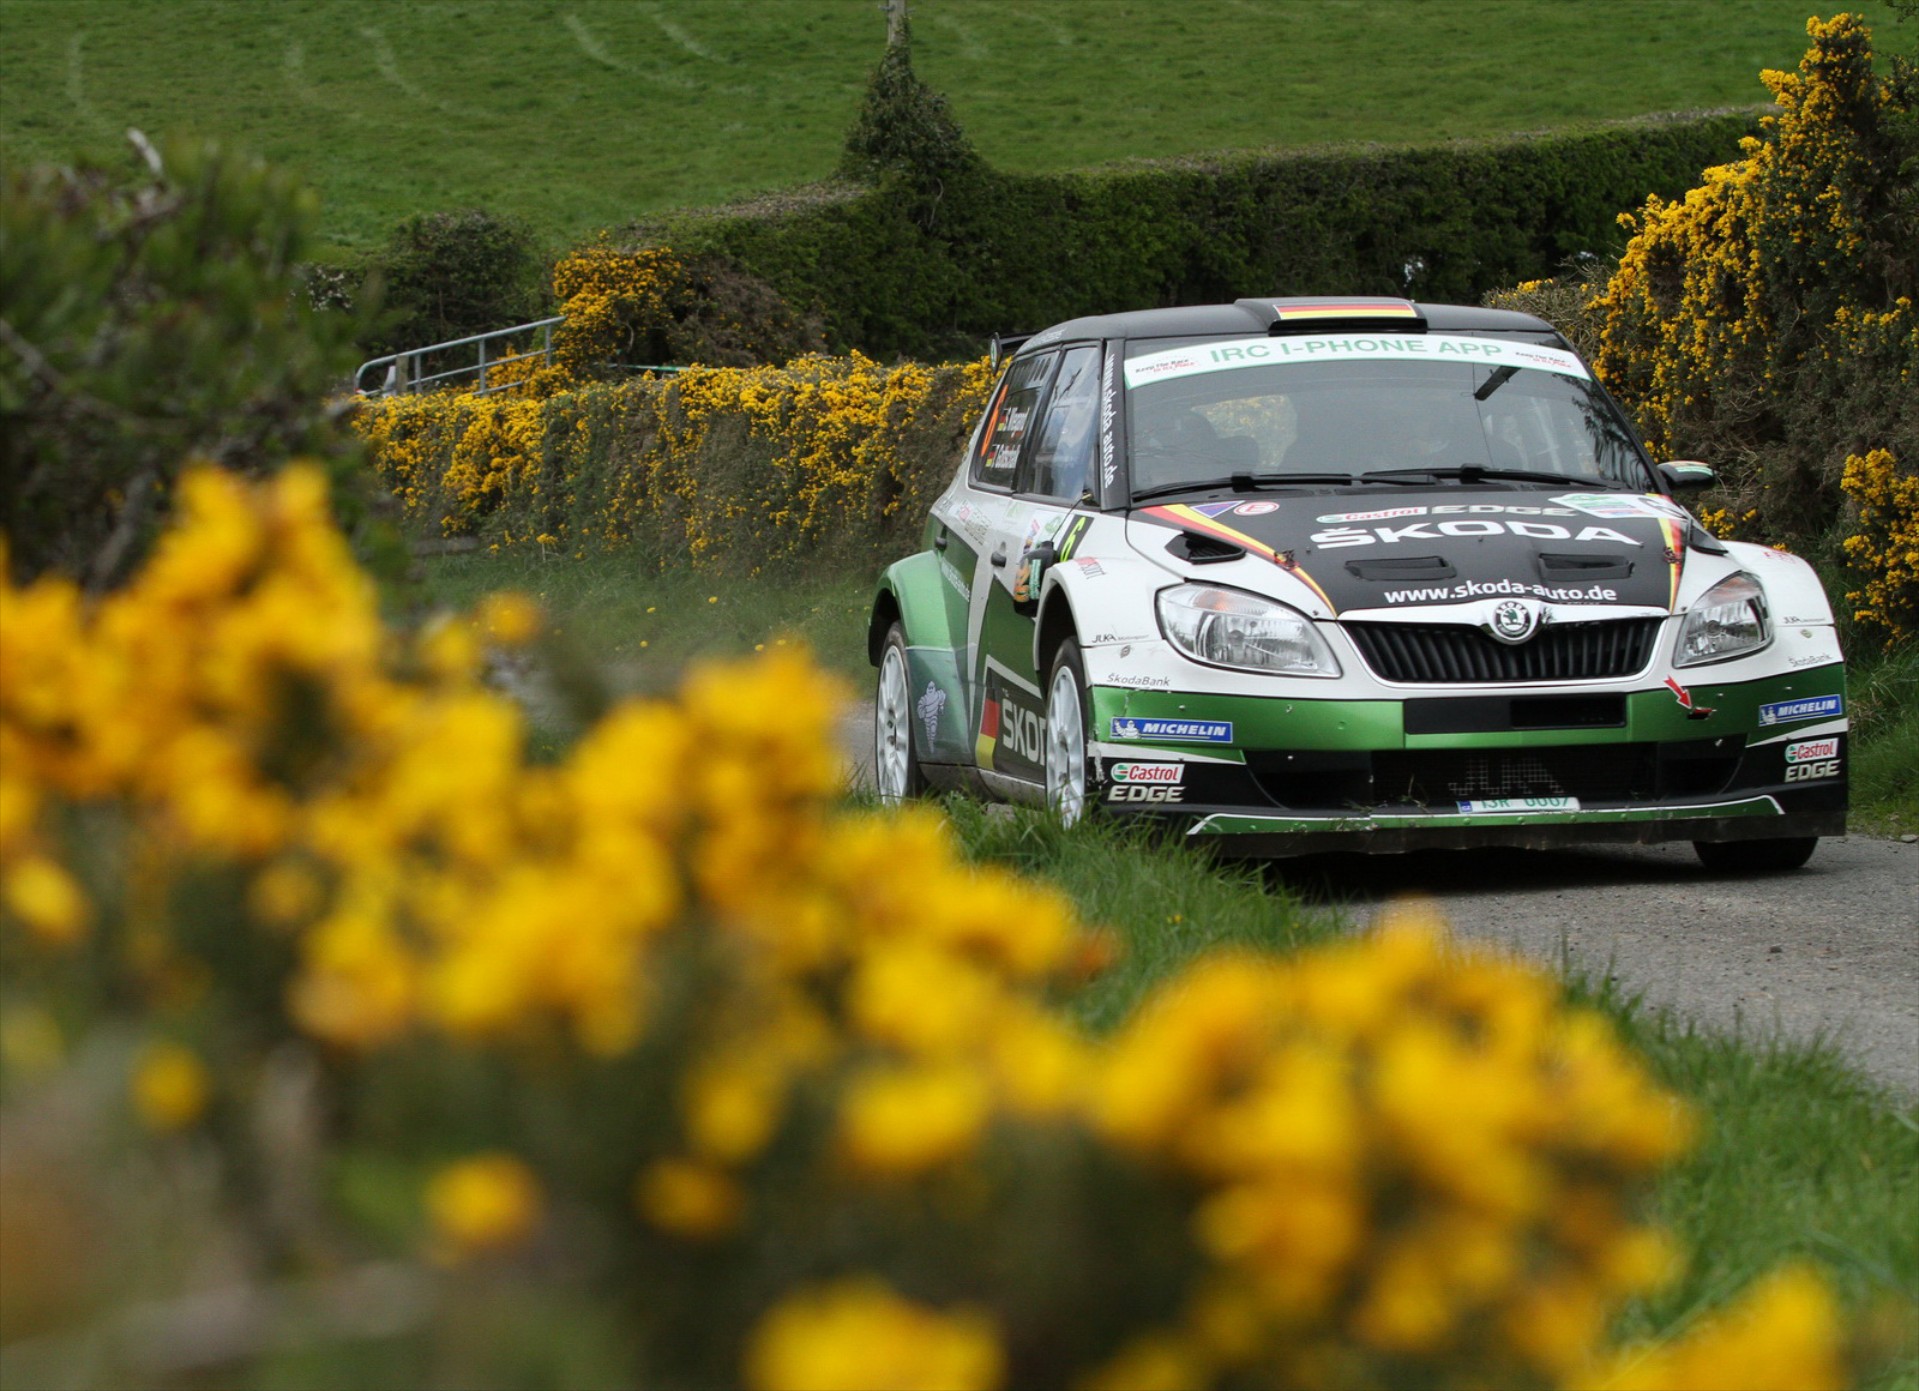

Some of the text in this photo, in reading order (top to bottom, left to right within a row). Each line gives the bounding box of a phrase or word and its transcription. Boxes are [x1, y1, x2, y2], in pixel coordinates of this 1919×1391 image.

[1210, 339, 1501, 362] IRC I-PHONE APP
[1345, 508, 1418, 521] Castrol
[1430, 503, 1579, 517] EDGE
[1060, 515, 1086, 562] 6
[1310, 520, 1644, 550] ŠKODA
[1384, 577, 1617, 604] www.skoda-auto.de
[1107, 672, 1171, 687] ŠkodaBank
[1777, 699, 1836, 717] MICHELIN
[1142, 722, 1227, 736] MICHELIN
[1797, 741, 1834, 760] Castrol
[1129, 765, 1179, 781] Castrol
[1784, 759, 1842, 783] EDGE
[1107, 784, 1187, 802] EDGE
